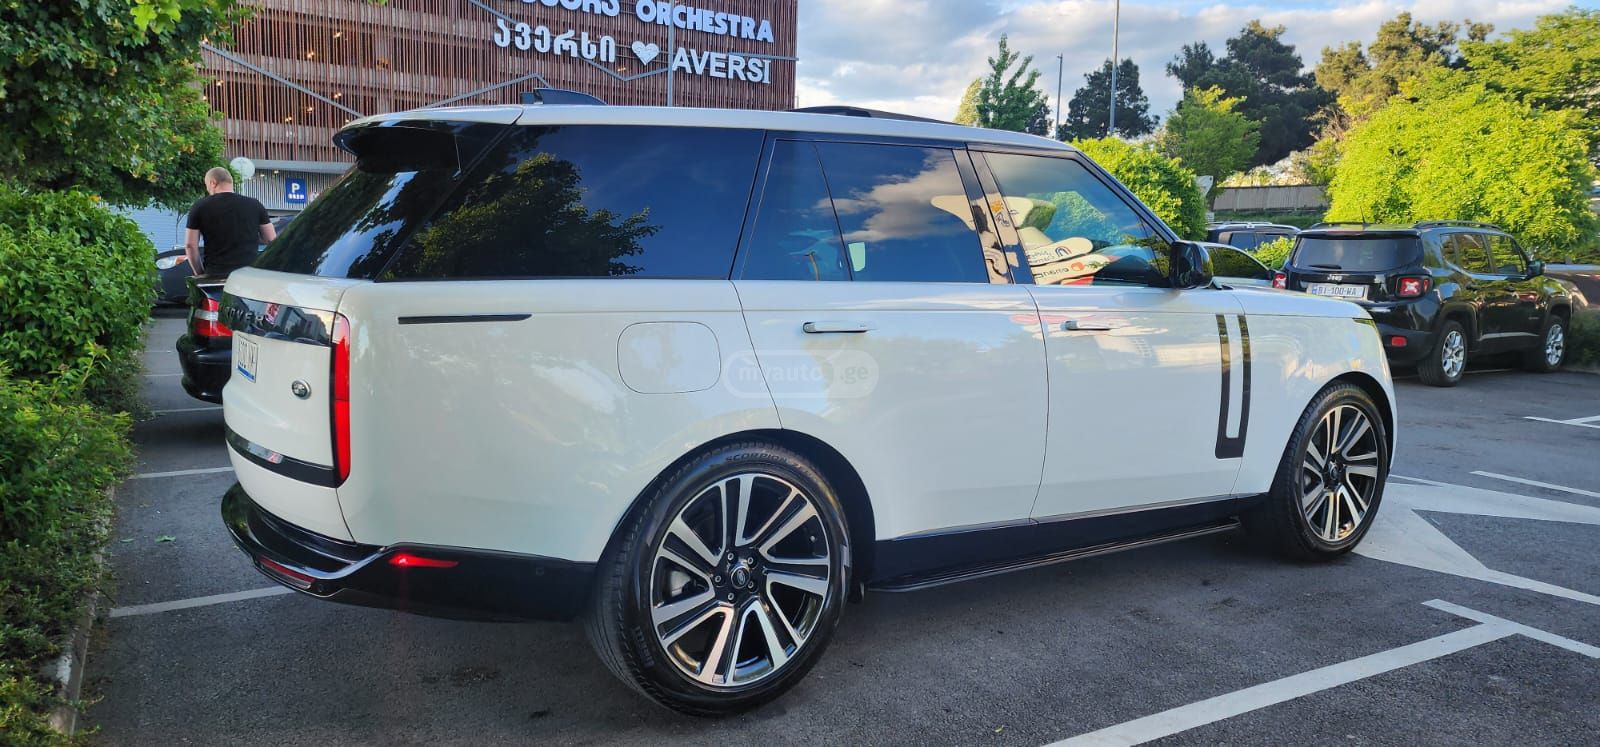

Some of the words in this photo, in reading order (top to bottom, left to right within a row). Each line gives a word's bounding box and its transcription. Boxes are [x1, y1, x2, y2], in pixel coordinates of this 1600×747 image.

[493, 18, 616, 63] ავერსი
[635, 0, 775, 43] ORCHESTRA
[671, 46, 772, 85] AVERSI
[291, 182, 300, 194] P
[725, 452, 789, 463] SCORPION
